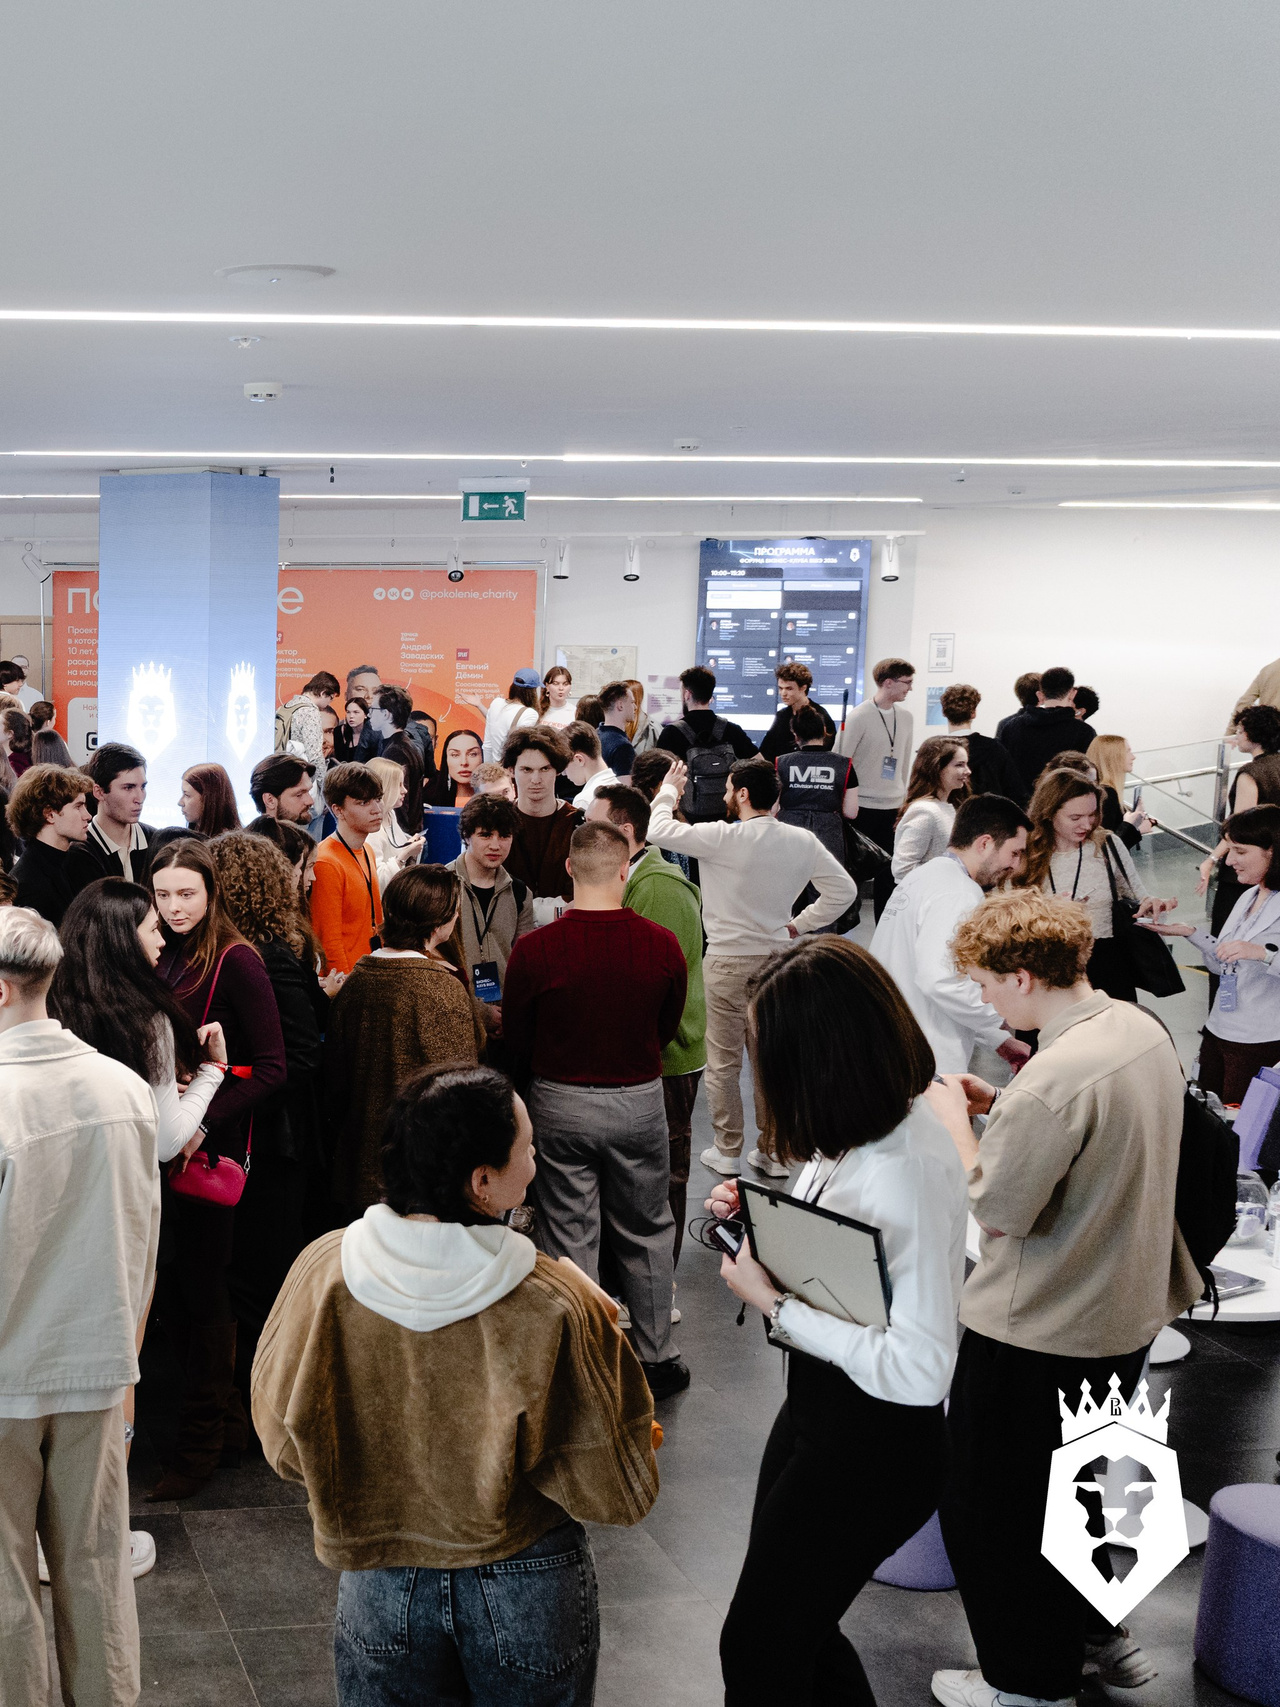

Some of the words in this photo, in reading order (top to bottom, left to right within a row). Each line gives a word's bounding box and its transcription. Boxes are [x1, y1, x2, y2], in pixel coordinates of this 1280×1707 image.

[754, 547, 816, 556] ПРОГРАММА
[420, 590, 518, 600] @pokolenie_charity
[68, 626, 98, 636] Проект
[75, 638, 98, 646] котор
[68, 647, 77, 655] 10
[400, 643, 432, 651] Андрей
[400, 652, 445, 660] Завадских
[456, 662, 489, 670] Евгений
[455, 672, 483, 680] Дёмин
